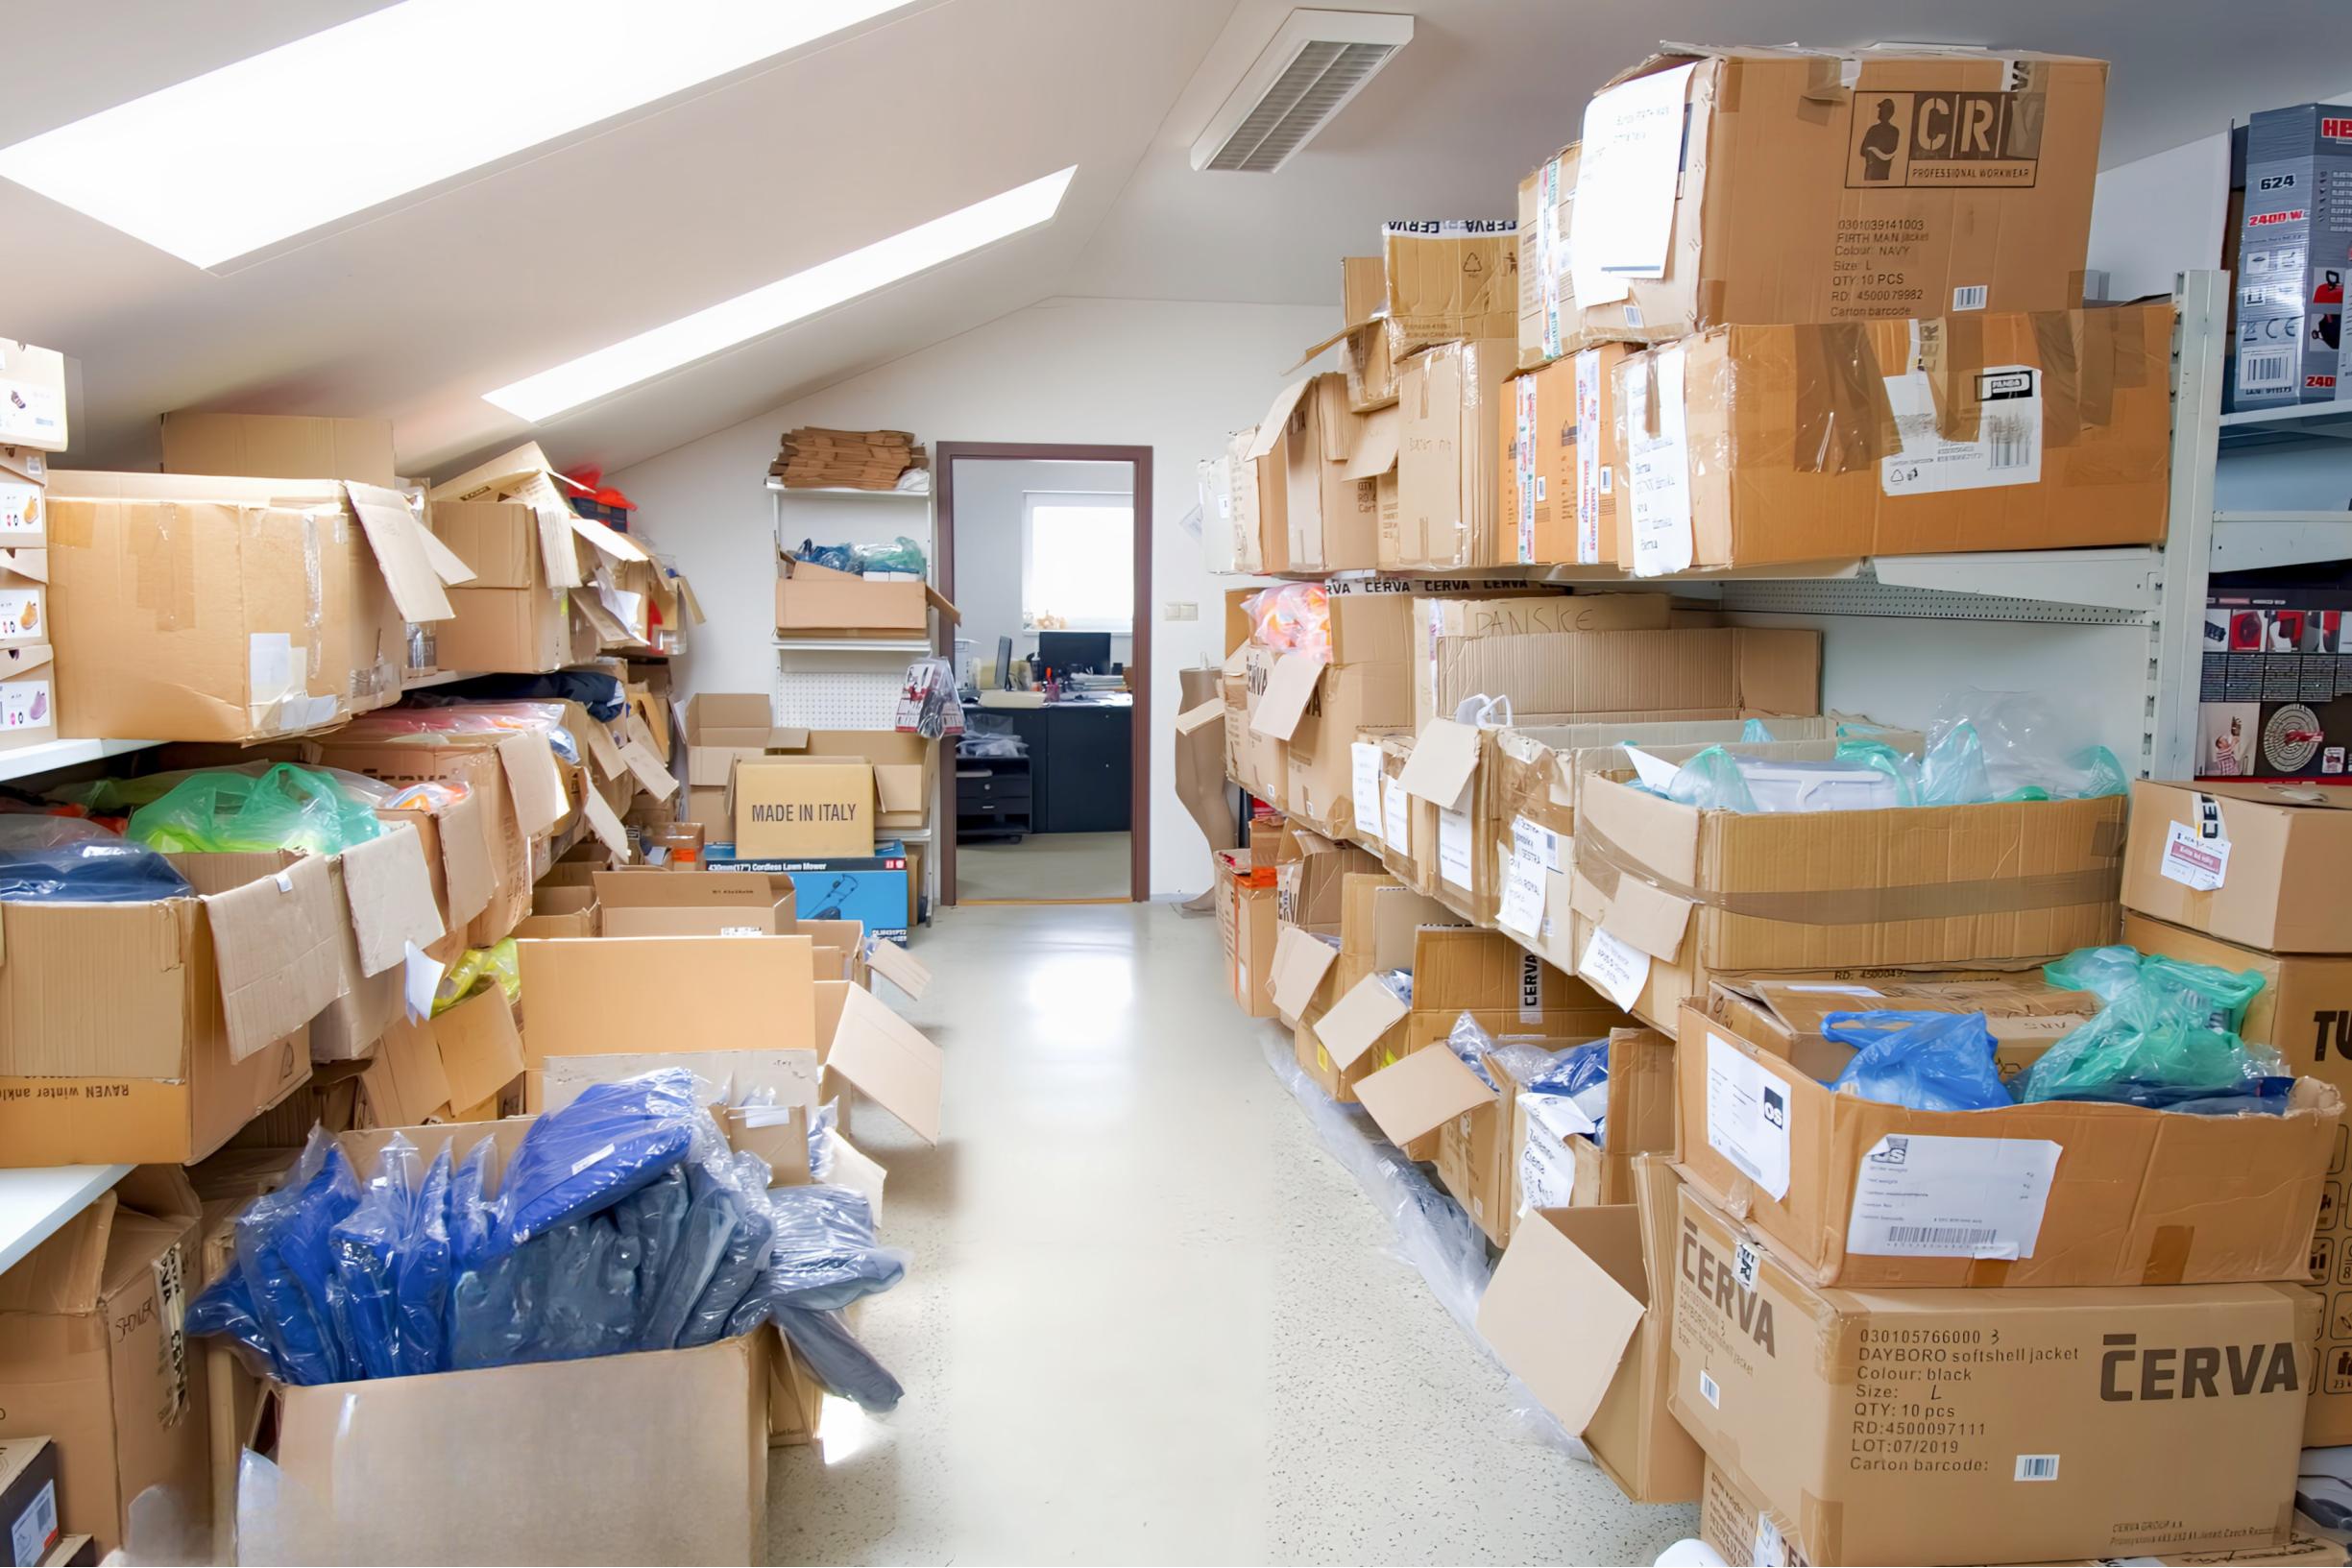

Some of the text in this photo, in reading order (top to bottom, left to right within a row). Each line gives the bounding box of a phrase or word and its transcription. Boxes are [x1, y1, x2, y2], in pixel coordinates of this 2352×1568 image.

[1912, 168, 2030, 179] PROFESSIONAL WORKWEAR
[2261, 175, 2294, 190] 624
[2249, 209, 2303, 227] 2400 W
[1837, 233, 1870, 243] FIRTH
[1873, 232, 1899, 243] MAN
[1879, 246, 1911, 256] NAVY
[1865, 261, 1873, 271] L
[1861, 275, 1874, 285] 10
[1878, 274, 1904, 285] PCS
[1365, 581, 1411, 592] CERVA
[1424, 579, 1470, 591] CERVA
[752, 804, 857, 822] MADE IN ITALY
[36, 1087, 79, 1099] winter
[85, 1084, 129, 1098] RAVEN
[1859, 1328, 2000, 1344] 030105766000 3
[1858, 1346, 2079, 1363] DAYBORO softshell jacket
[1856, 1365, 1973, 1381] Colour: black
[1855, 1384, 1943, 1401] Size: L
[1854, 1402, 1956, 1420] QTY: 10 pcs
[1853, 1421, 1986, 1435] RD:4500097111
[1851, 1438, 1959, 1454] LOT:07/2019
[1850, 1456, 1989, 1472] Carton barcode:
